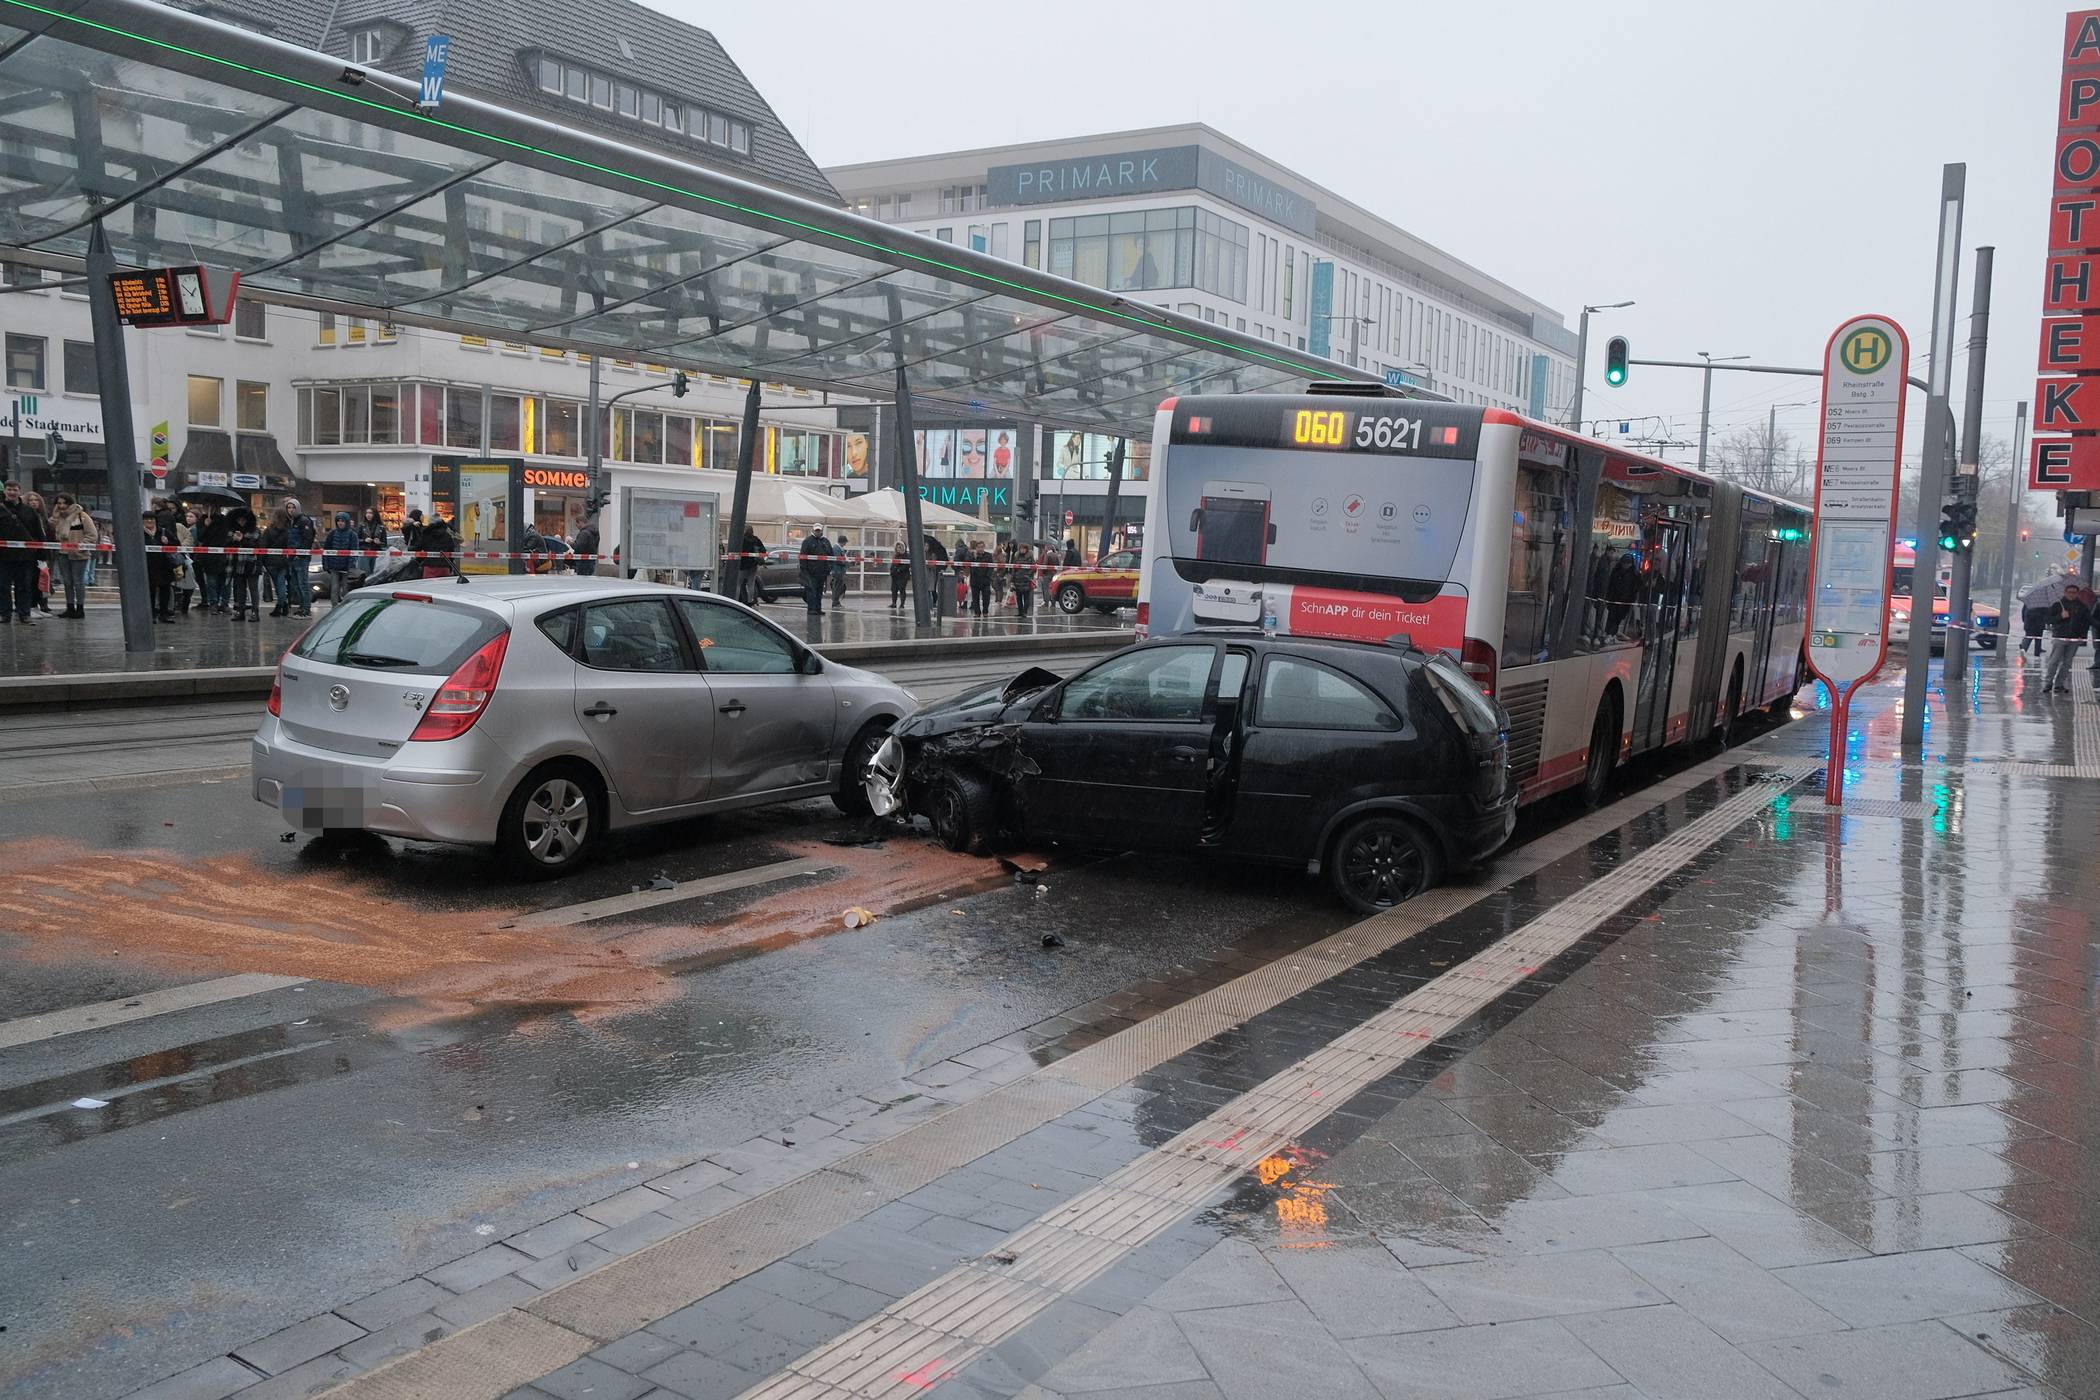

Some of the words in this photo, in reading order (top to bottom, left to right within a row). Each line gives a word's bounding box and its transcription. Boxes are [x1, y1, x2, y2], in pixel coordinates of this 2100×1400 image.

[426, 44, 447, 63] ME
[423, 76, 443, 101] W
[1018, 157, 1160, 195] PRIMARK
[1224, 167, 1296, 220] PRIMARK
[2036, 15, 2100, 484] APOTHEKE
[1853, 336, 1879, 365] H
[1827, 408, 1843, 416] 052
[25, 417, 100, 434] Stadtmarkt
[1294, 409, 1346, 446] 060
[1354, 416, 1423, 450] 5621
[1826, 422, 1842, 431] 057
[1825, 436, 1842, 445] 069
[898, 485, 1008, 506] RIMARK
[1300, 601, 1350, 617] SchnAPP
[1351, 606, 1366, 618] dir
[1368, 608, 1392, 621] dein
[1395, 610, 1431, 625] Ticket!
